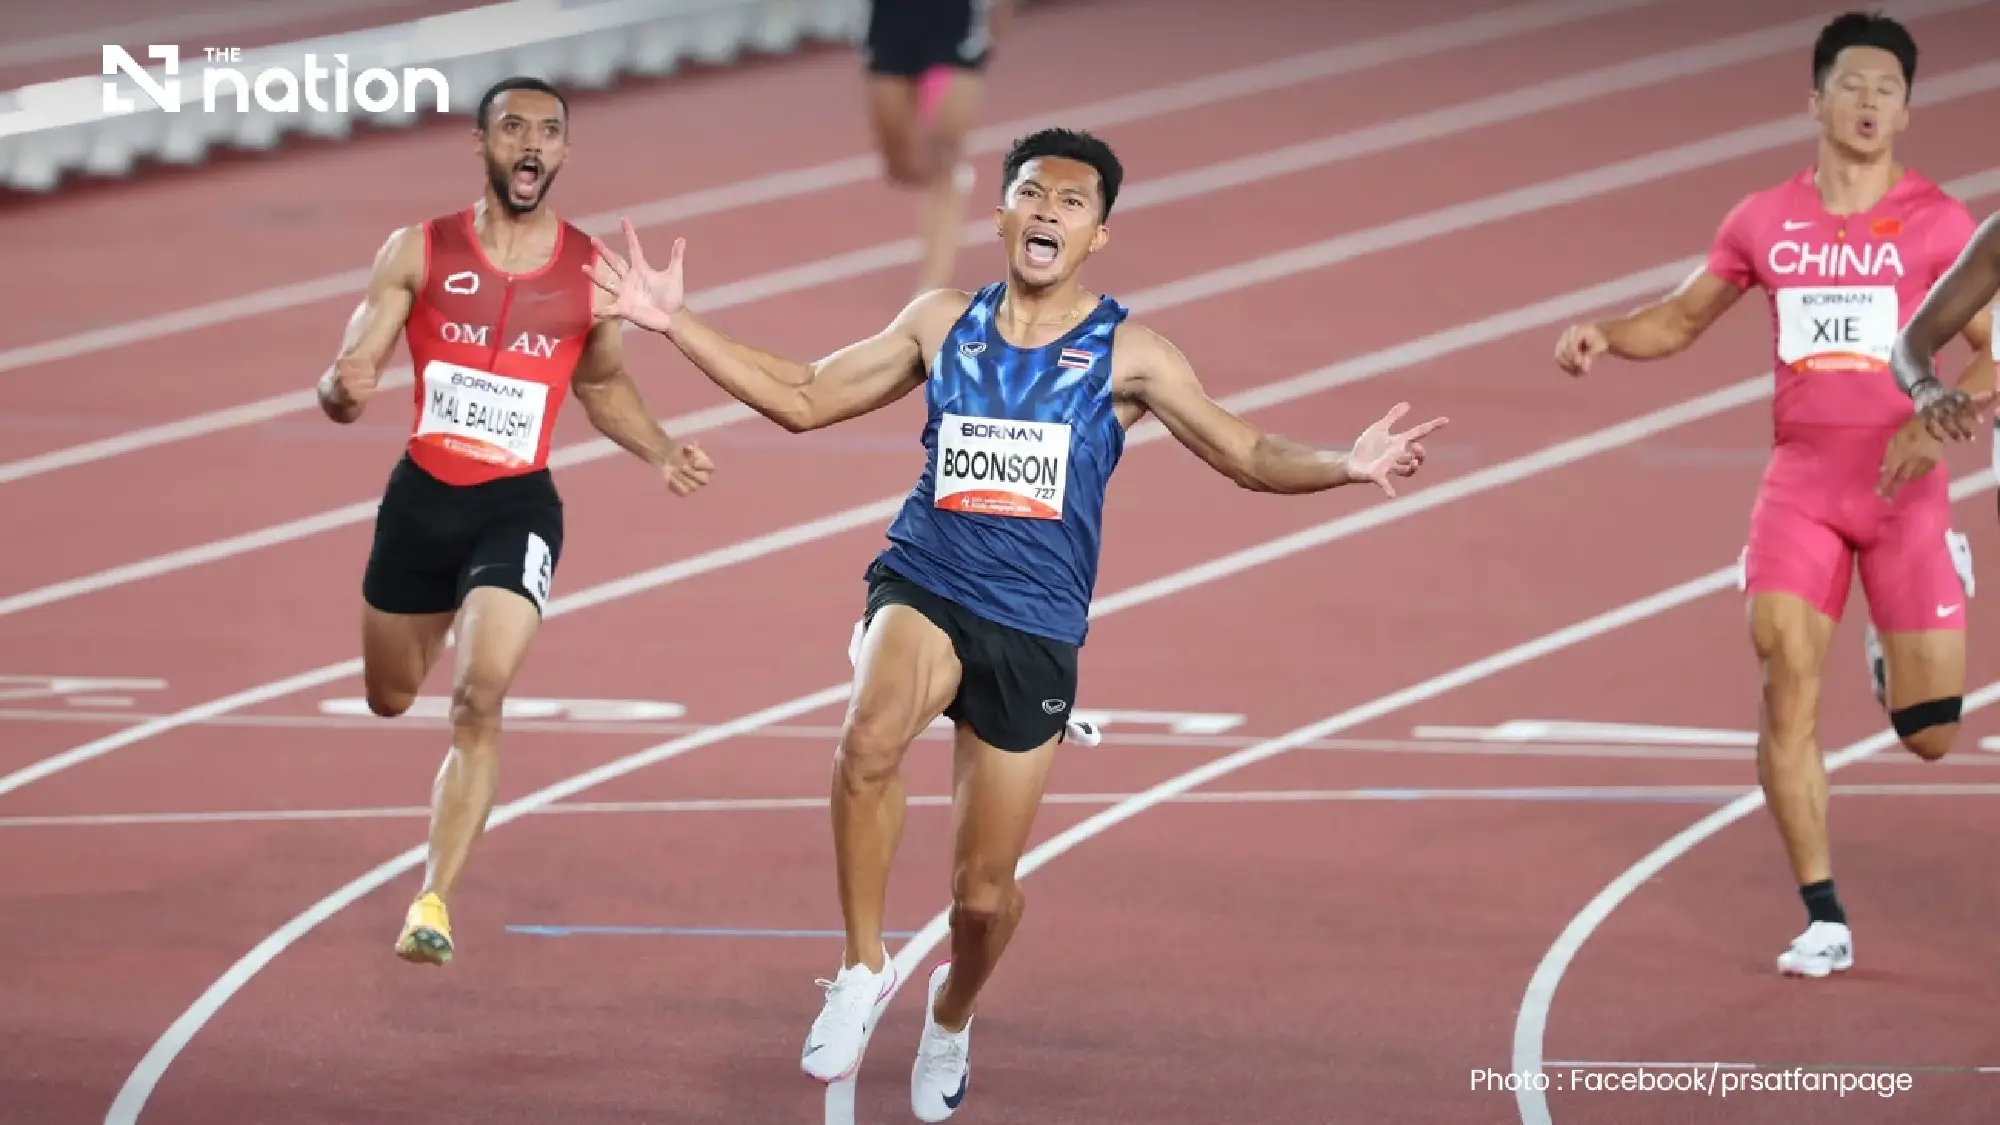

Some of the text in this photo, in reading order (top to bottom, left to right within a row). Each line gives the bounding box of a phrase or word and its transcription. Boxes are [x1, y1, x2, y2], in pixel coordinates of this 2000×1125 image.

[1768, 240, 1904, 277] CHINA
[1812, 316, 1861, 343] XIE
[451, 372, 524, 399] BORNAN
[465, 402, 535, 438] BALUSHI
[960, 422, 1043, 442] BORNAN
[942, 447, 1058, 486] BOONSON
[1034, 487, 1056, 500] 727
